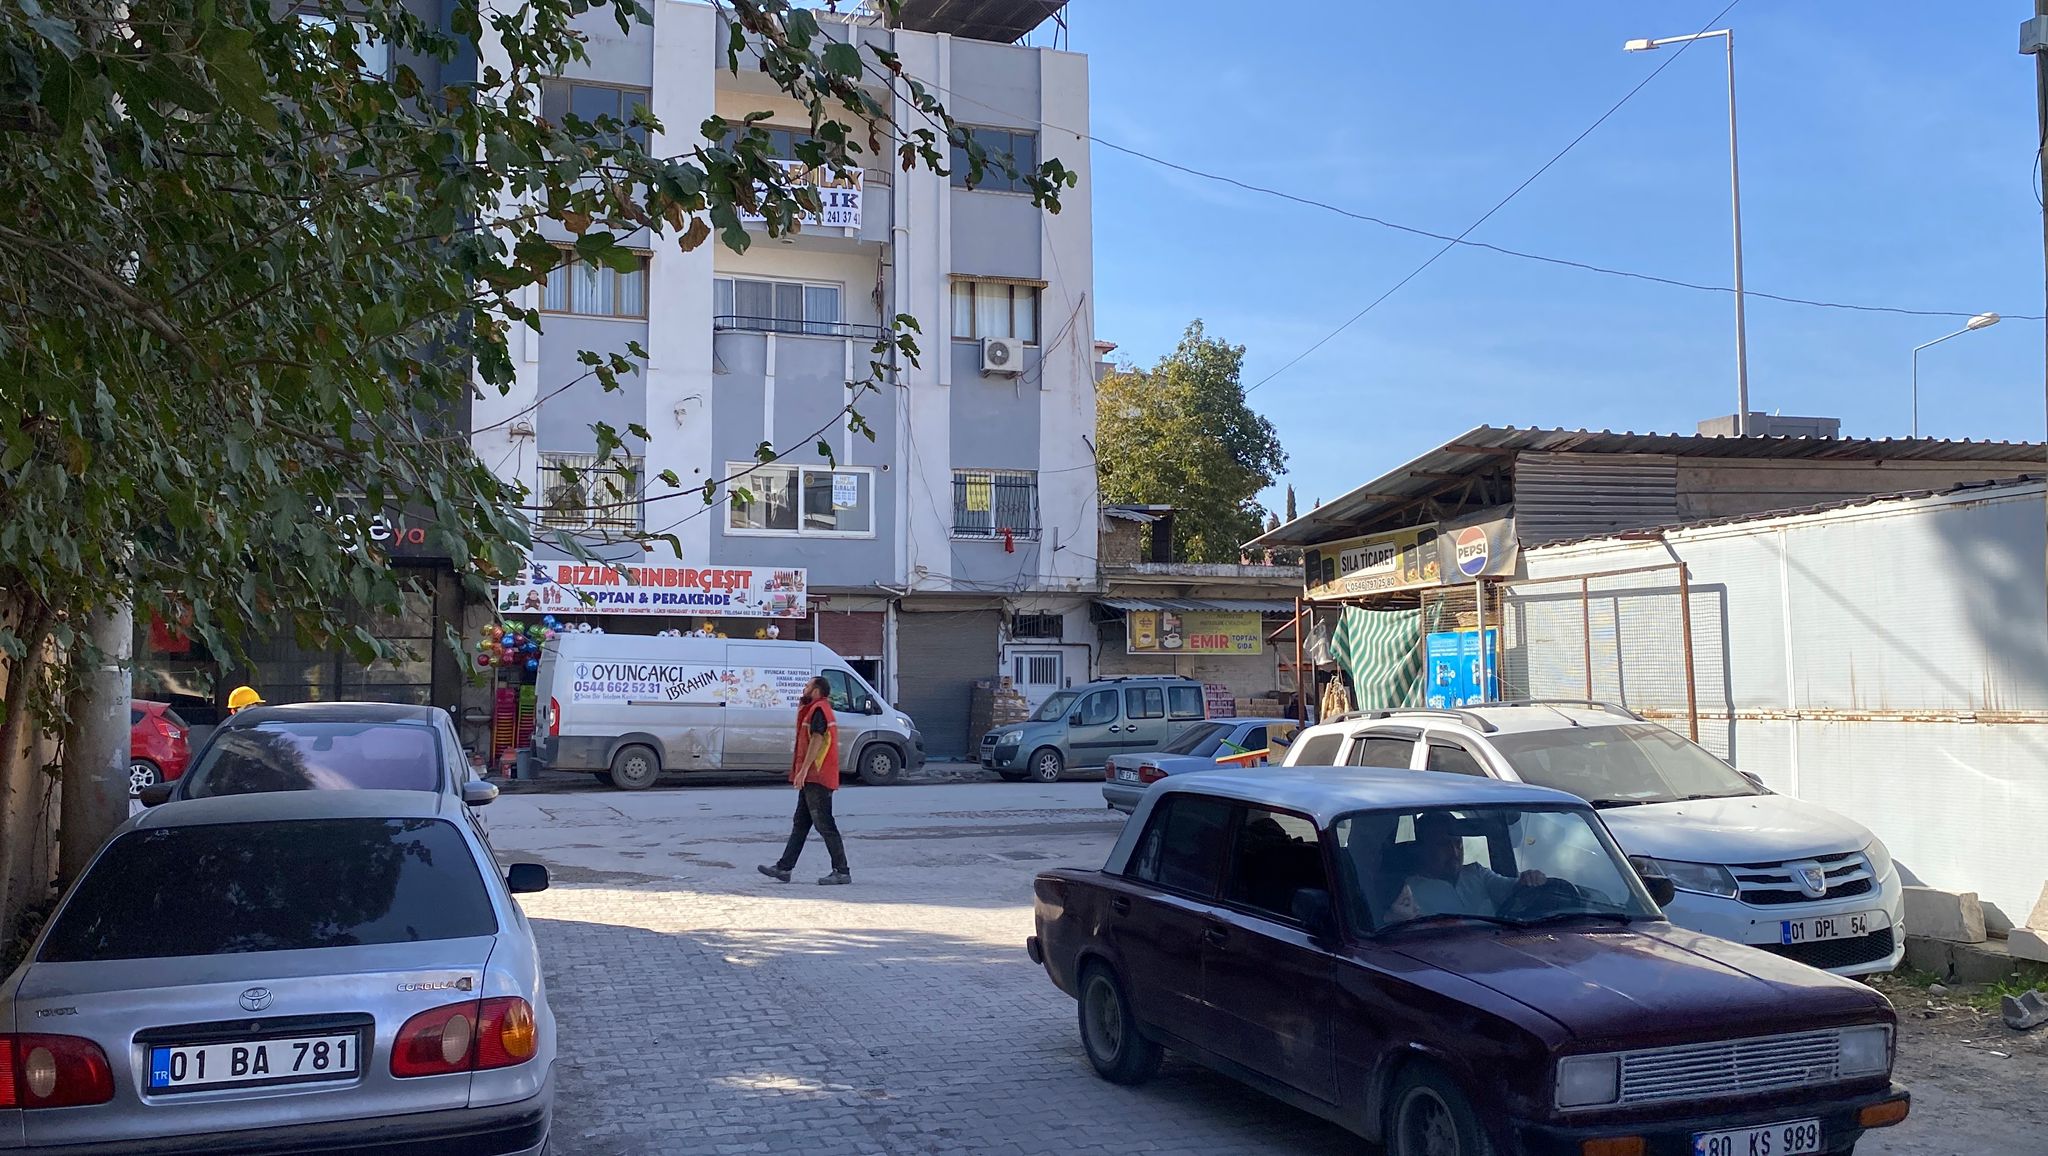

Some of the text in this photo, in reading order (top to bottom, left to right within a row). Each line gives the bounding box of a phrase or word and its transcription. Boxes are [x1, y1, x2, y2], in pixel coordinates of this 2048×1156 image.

[827, 211, 840, 222] 241
[843, 211, 852, 223] 37
[1341, 554, 1359, 572] SILA
[1360, 548, 1394, 569] TİCARET
[1458, 547, 1487, 560] PEPSI
[1350, 580, 1366, 590] 0546
[1386, 577, 1395, 587] 80
[587, 591, 731, 606] OPTAN & PERAKENDE
[592, 663, 683, 685] OYUNCAKÇI
[665, 669, 719, 701] İBRAHİM
[574, 681, 661, 694] 0544 662 52 31
[1791, 916, 1866, 940] 01 DPL 54
[153, 1039, 347, 1081] TR 01 BA 781
[1708, 1124, 1816, 1156] 80 KS 989
